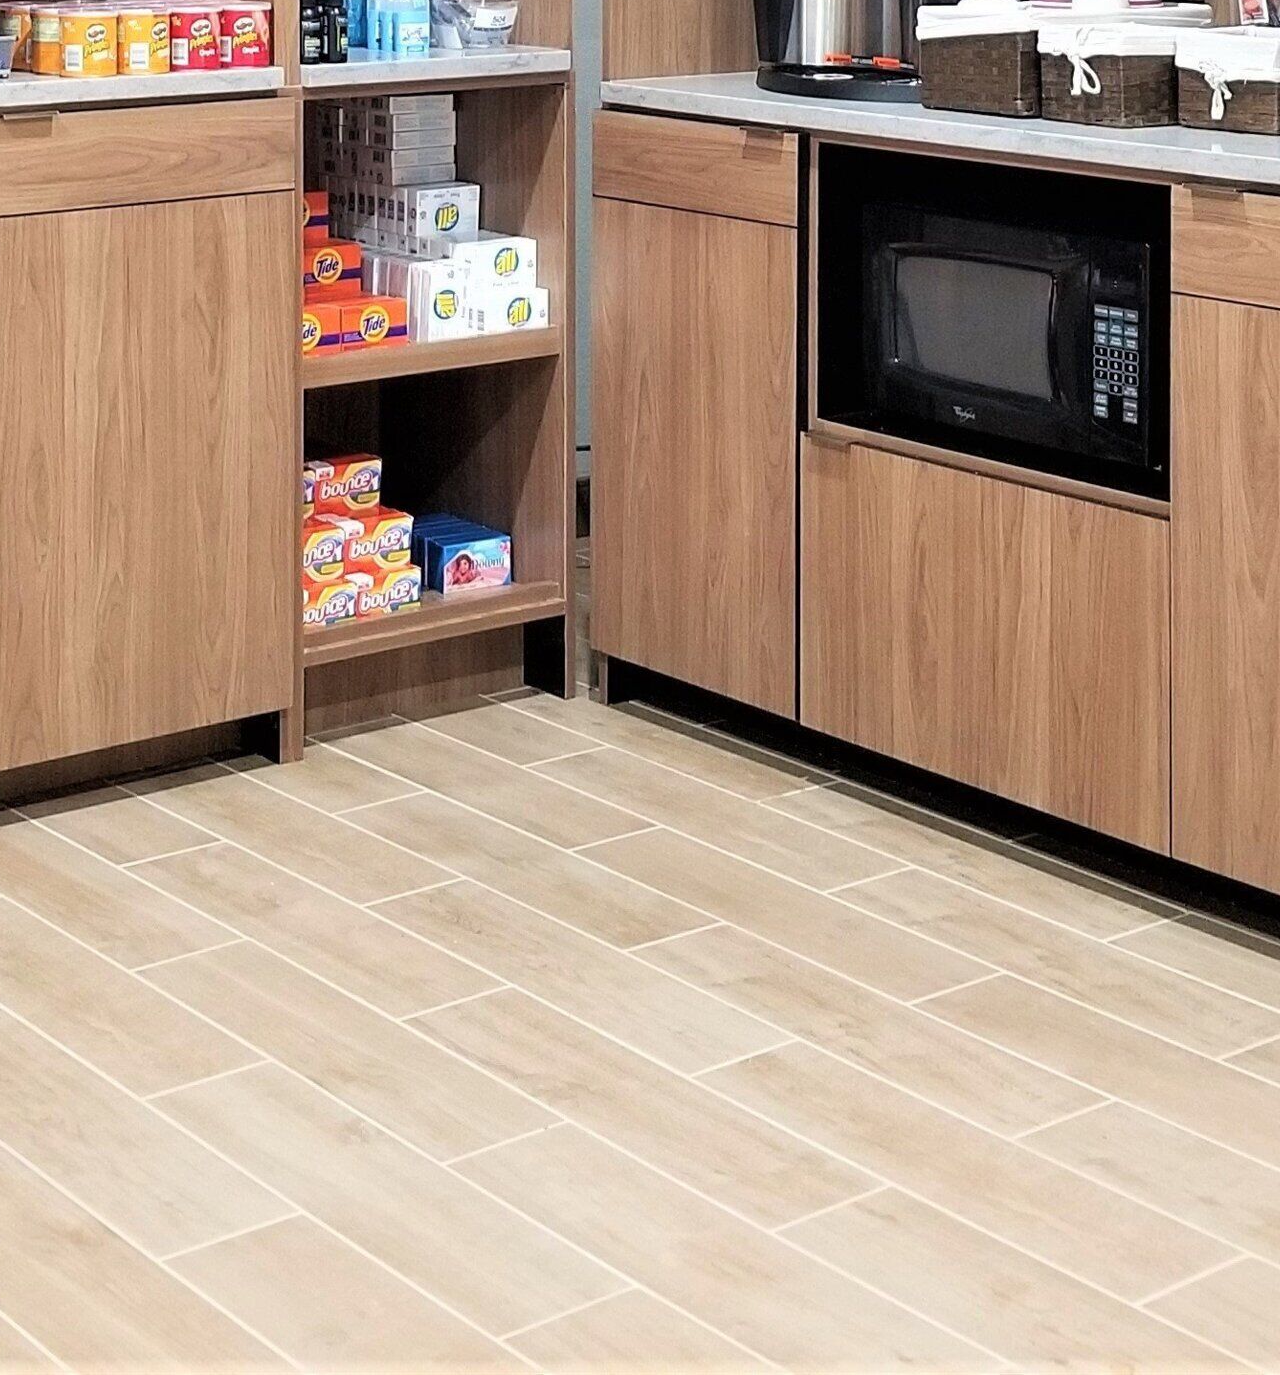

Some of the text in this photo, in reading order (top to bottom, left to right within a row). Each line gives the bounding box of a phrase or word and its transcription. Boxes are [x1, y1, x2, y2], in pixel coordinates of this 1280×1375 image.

[316, 257, 339, 277] Tide
[495, 248, 517, 274] all
[362, 314, 387, 335] Tide
[508, 298, 529, 327] all
[321, 472, 371, 500] bounce
[350, 530, 401, 560] bounce
[361, 582, 411, 613] bounce
